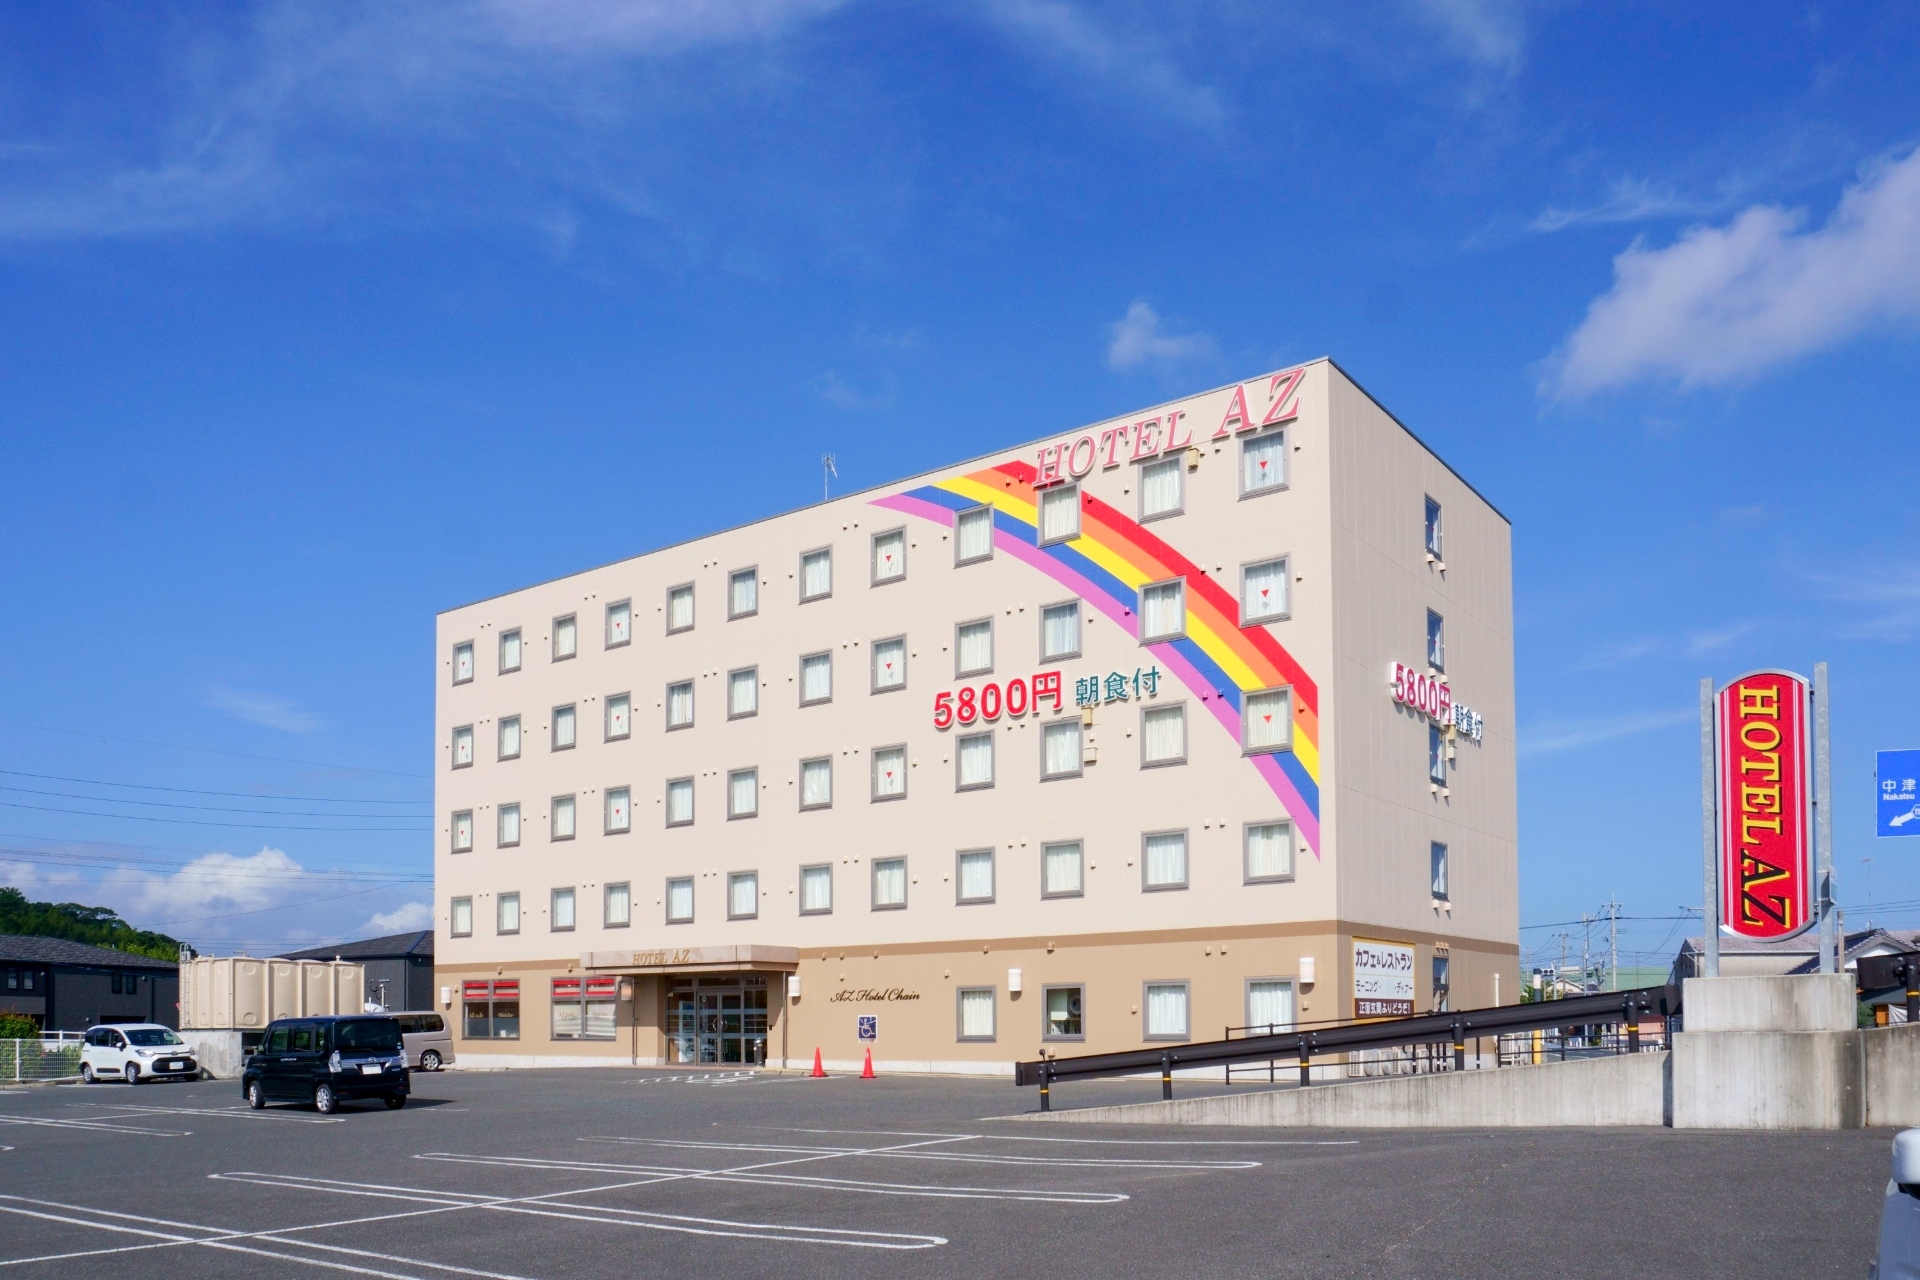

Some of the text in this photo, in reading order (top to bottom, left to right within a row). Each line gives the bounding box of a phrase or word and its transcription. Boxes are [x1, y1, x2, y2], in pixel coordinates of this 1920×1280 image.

[1032, 367, 1306, 488] HOTEL AZ
[933, 665, 1161, 729] 5800円 朝食付
[1391, 662, 1451, 725] 5800円
[1882, 779, 1917, 793] 中津
[1883, 793, 1915, 801] Nakatsu
[1739, 684, 1791, 929] HOTEL AZ
[632, 949, 690, 966] HOTEL AZ
[830, 988, 920, 1002] AZ Hotel Chain
